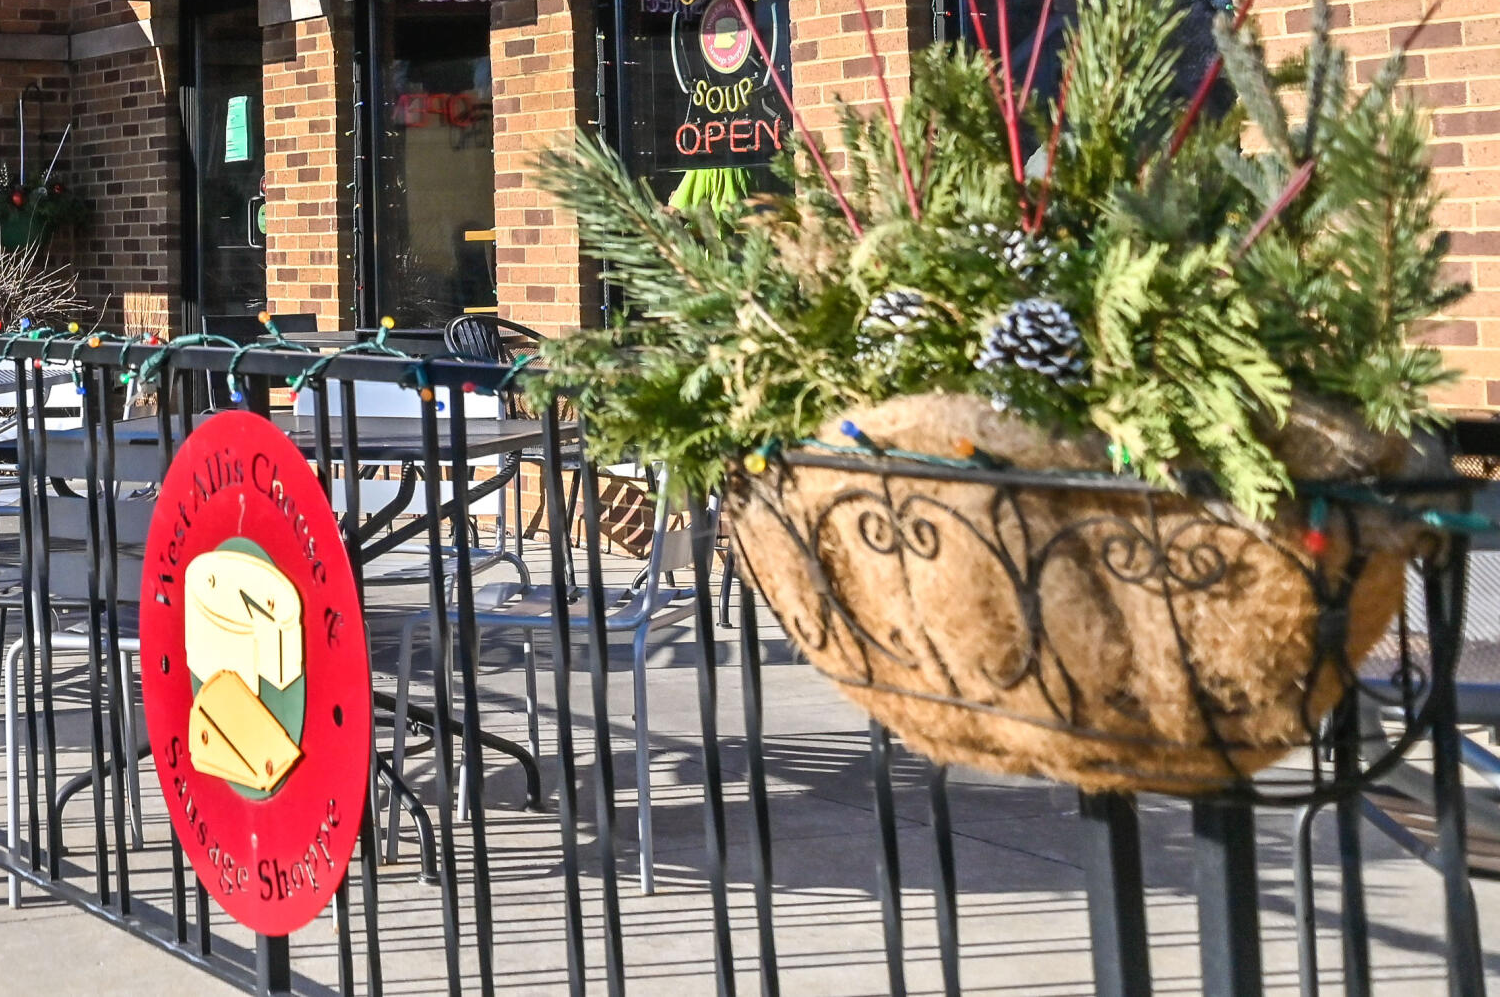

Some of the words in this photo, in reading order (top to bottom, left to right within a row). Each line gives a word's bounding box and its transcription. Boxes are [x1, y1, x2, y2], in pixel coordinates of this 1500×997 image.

[675, 116, 783, 156] OPEN
[693, 77, 753, 114] SOUP
[155, 501, 191, 607] West
[193, 448, 245, 513] Allis
[251, 452, 327, 585] Cheese
[165, 735, 250, 895] Sausage
[257, 798, 342, 902] Shoppe
